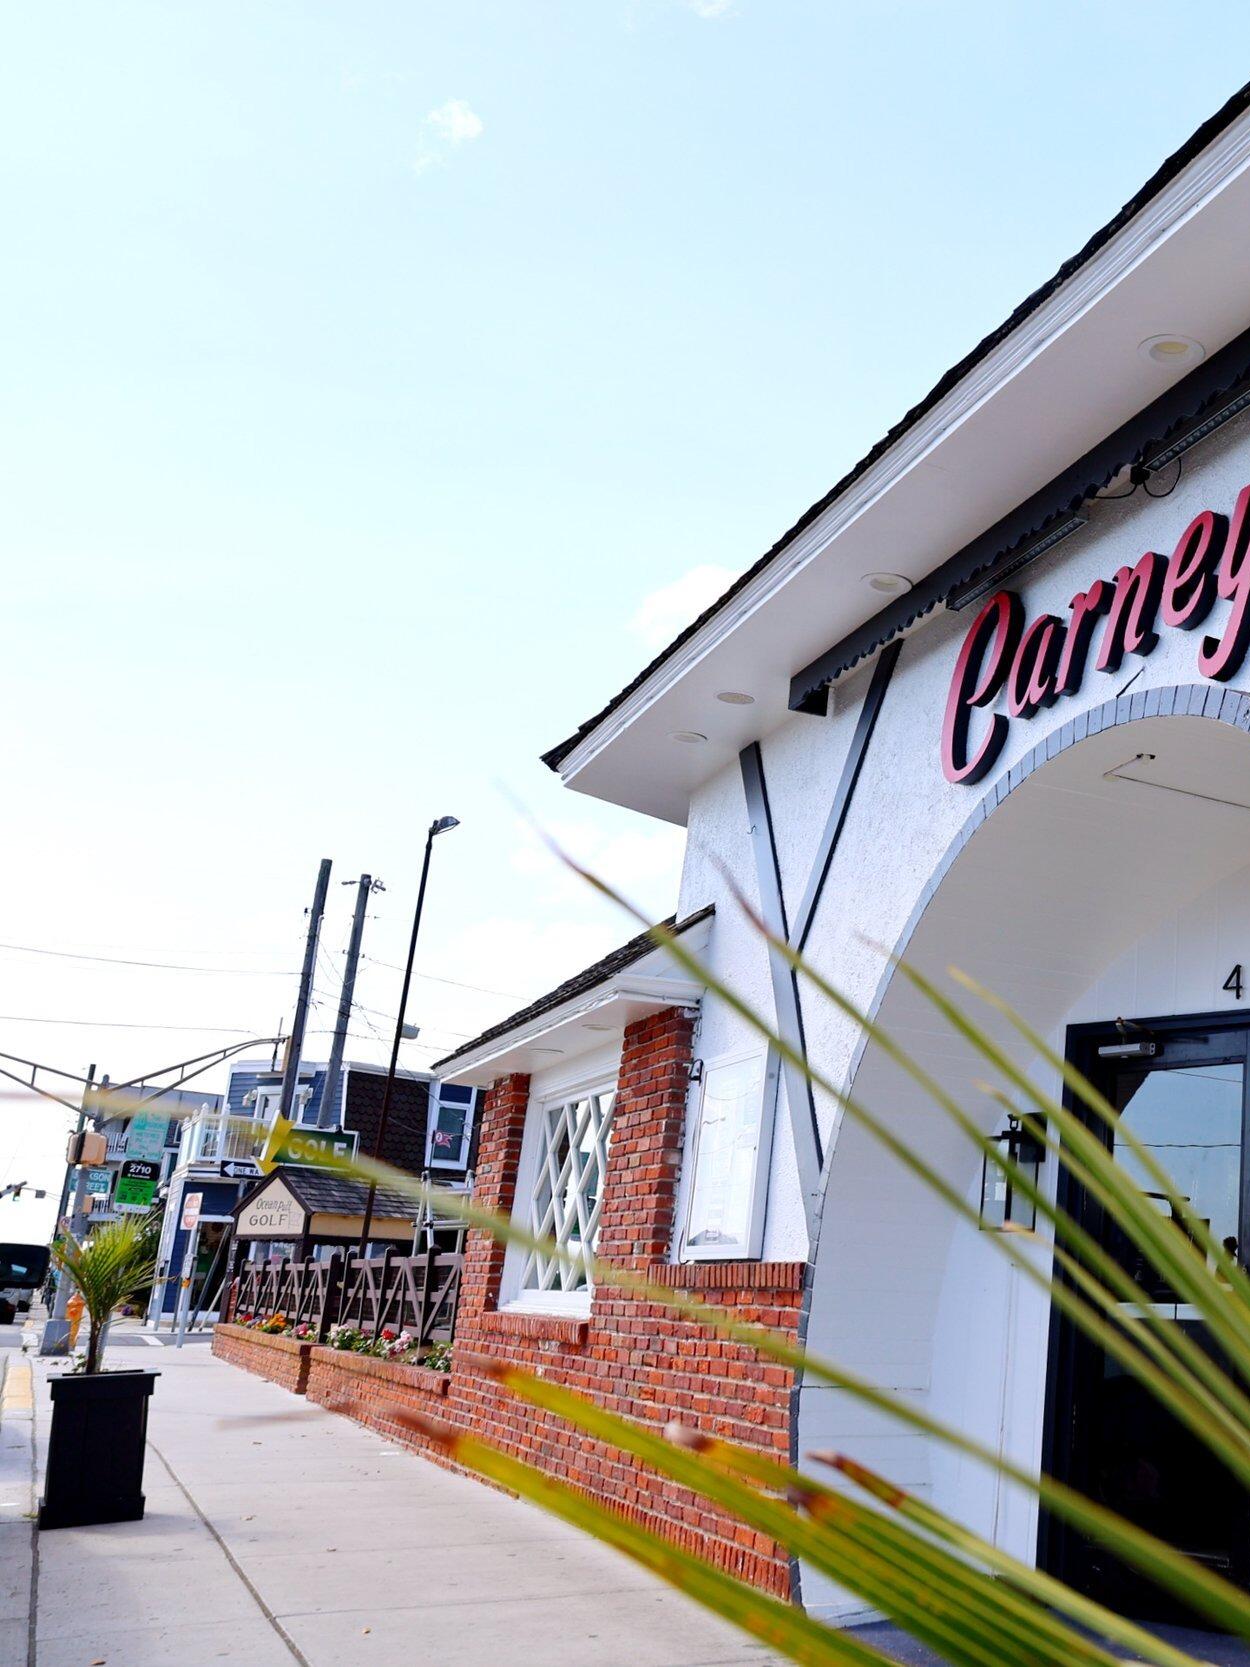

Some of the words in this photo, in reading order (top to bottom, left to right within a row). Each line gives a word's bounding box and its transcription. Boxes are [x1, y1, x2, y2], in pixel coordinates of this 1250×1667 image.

[287, 1137, 348, 1161] GOLF
[129, 1164, 152, 1175] 2710
[249, 1213, 288, 1226] GOLF
